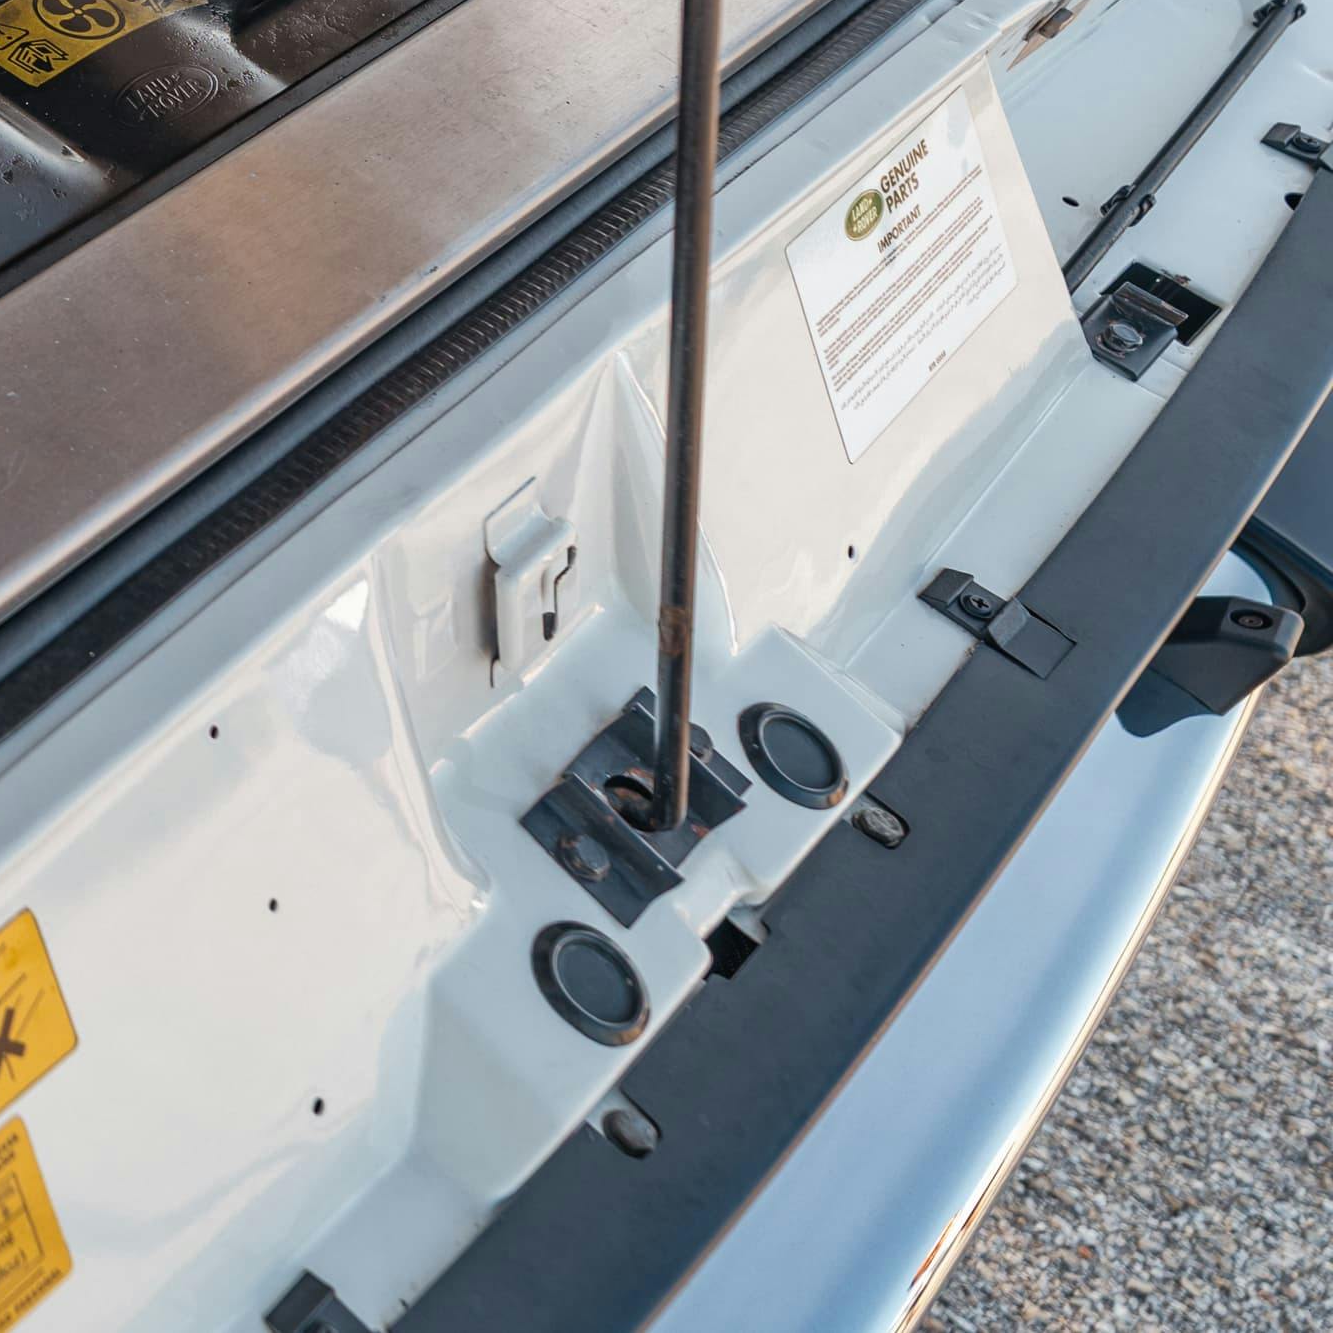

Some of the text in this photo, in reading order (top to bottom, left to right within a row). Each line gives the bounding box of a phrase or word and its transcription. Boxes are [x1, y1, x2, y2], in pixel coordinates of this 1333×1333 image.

[125, 72, 175, 111] LAND
[143, 80, 209, 119] ROVER
[879, 138, 930, 195] GENUINE
[850, 197, 873, 222] LAND
[884, 170, 920, 215] PARTS
[854, 206, 879, 235] ROVER
[876, 203, 922, 255] IMPORTANT
